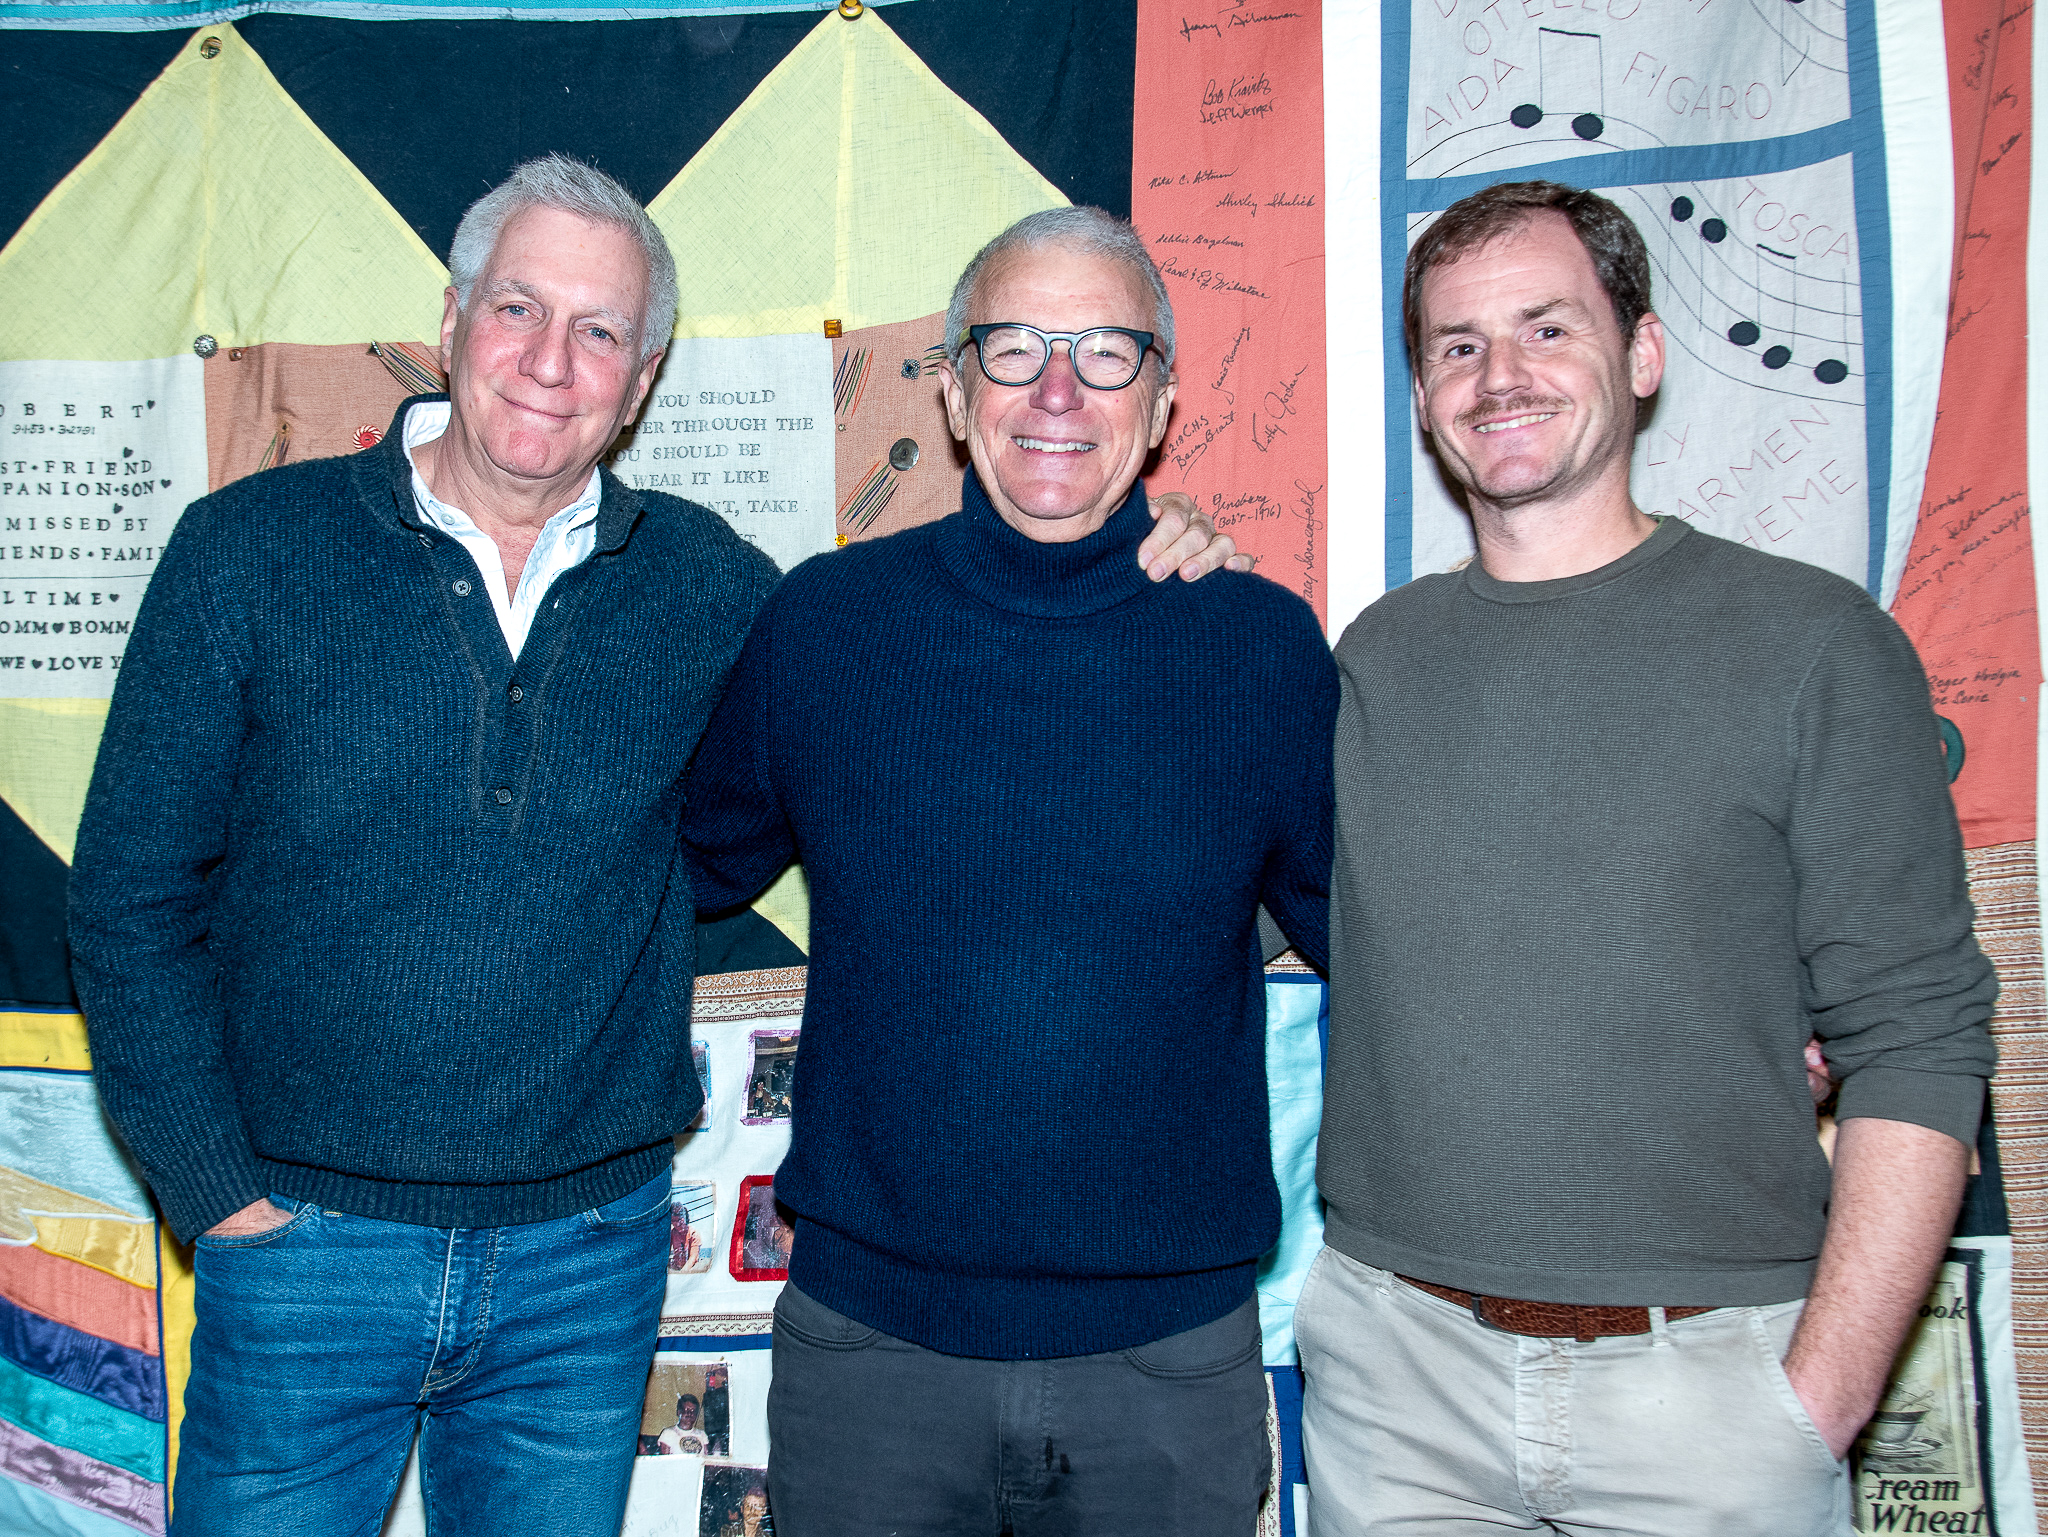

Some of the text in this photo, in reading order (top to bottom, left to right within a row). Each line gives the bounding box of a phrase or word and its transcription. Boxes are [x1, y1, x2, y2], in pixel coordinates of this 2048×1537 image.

[1463, 0, 1641, 55] OTEO
[1621, 51, 1772, 120] FIGARO
[1424, 58, 1524, 141] AIDA
[1736, 178, 1851, 265] TOSCA
[656, 389, 776, 408] YOU SHOULD
[671, 417, 767, 434] THROUGH
[776, 417, 814, 432] THE
[652, 443, 729, 460] SHOULD
[738, 443, 761, 457] BE
[1650, 405, 1830, 521] ARMEN
[633, 472, 683, 488] WEAR
[691, 471, 711, 485] IT
[723, 470, 769, 485] LIKE
[700, 500, 799, 517] NT, TAKE
[6, 517, 148, 532] MISSED BY
[49, 656, 104, 671] LOVE
